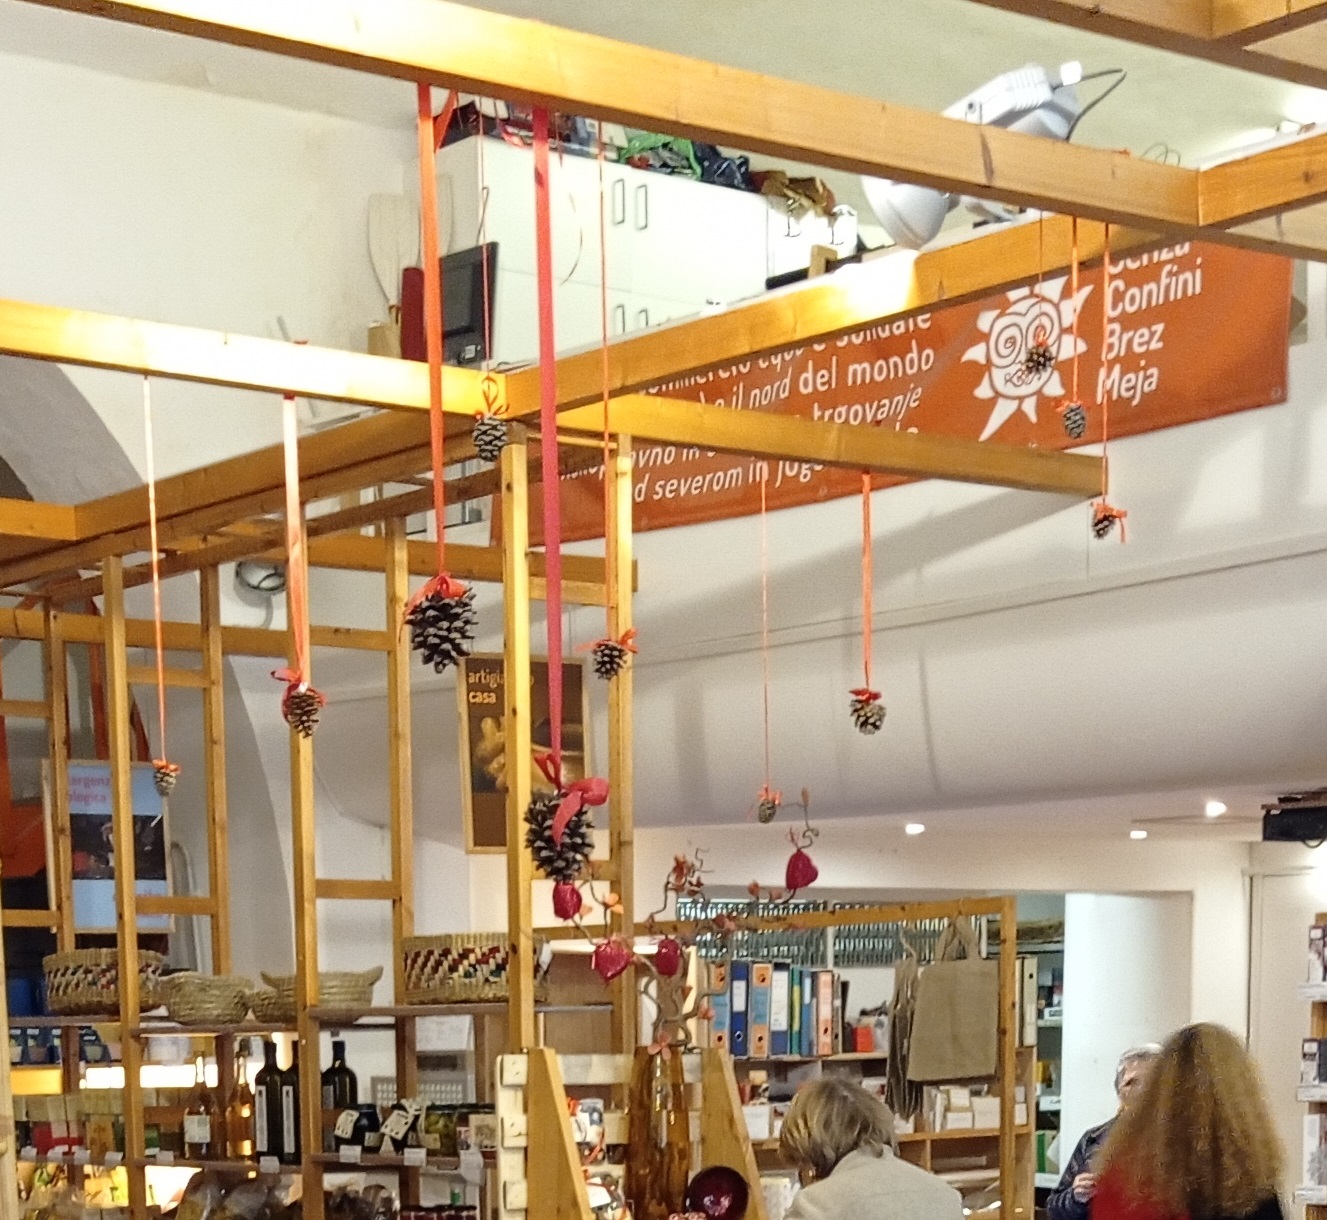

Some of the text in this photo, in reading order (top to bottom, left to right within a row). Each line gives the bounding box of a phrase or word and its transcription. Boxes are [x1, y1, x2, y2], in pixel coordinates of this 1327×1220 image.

[1106, 257, 1203, 319] Confini
[1101, 322, 1166, 362] Brez
[749, 366, 793, 410] nord
[799, 356, 837, 395] del
[848, 338, 935, 387] mondo
[1096, 360, 1160, 407] Meja
[652, 466, 743, 502] severom
[468, 690, 497, 705] casa
